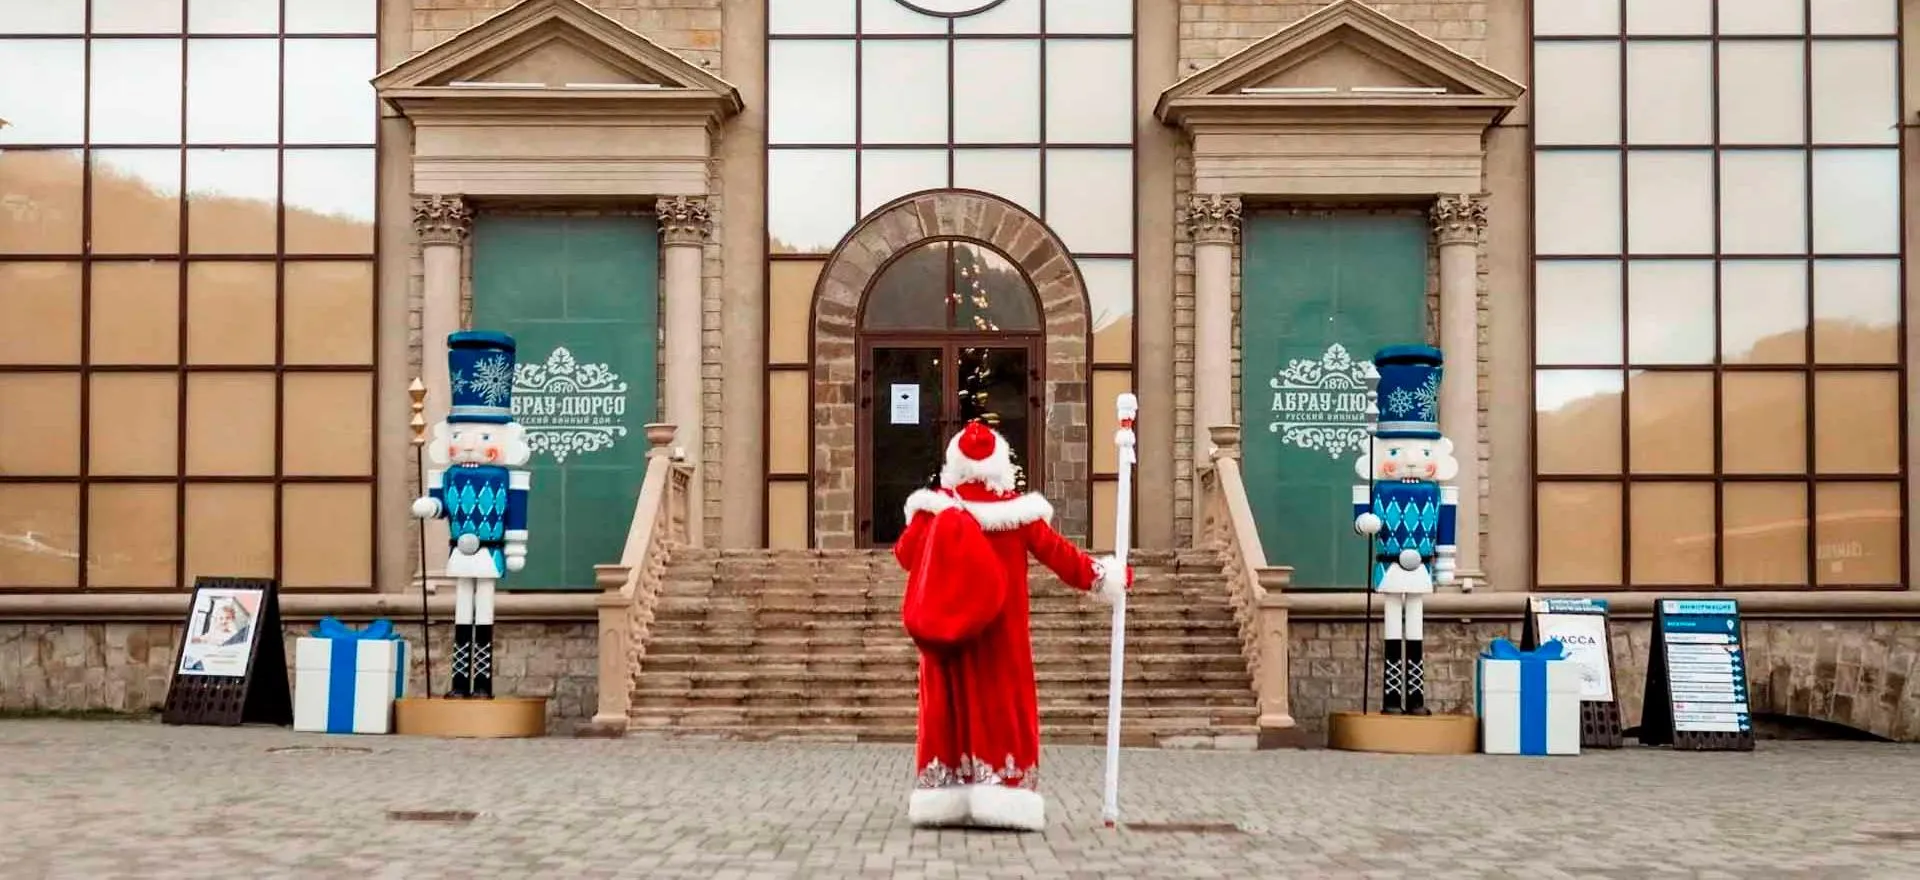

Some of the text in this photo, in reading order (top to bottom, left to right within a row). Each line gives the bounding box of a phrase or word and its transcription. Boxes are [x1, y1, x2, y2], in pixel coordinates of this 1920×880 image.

[548, 381, 574, 393] 1870
[1324, 378, 1348, 390] 1870
[551, 416, 590, 425] ВИННЫЙ
[592, 416, 611, 425] ДОМ
[1286, 412, 1366, 421] РУССКИЙ ВИННЫЙ
[1550, 633, 1596, 645] АССА
